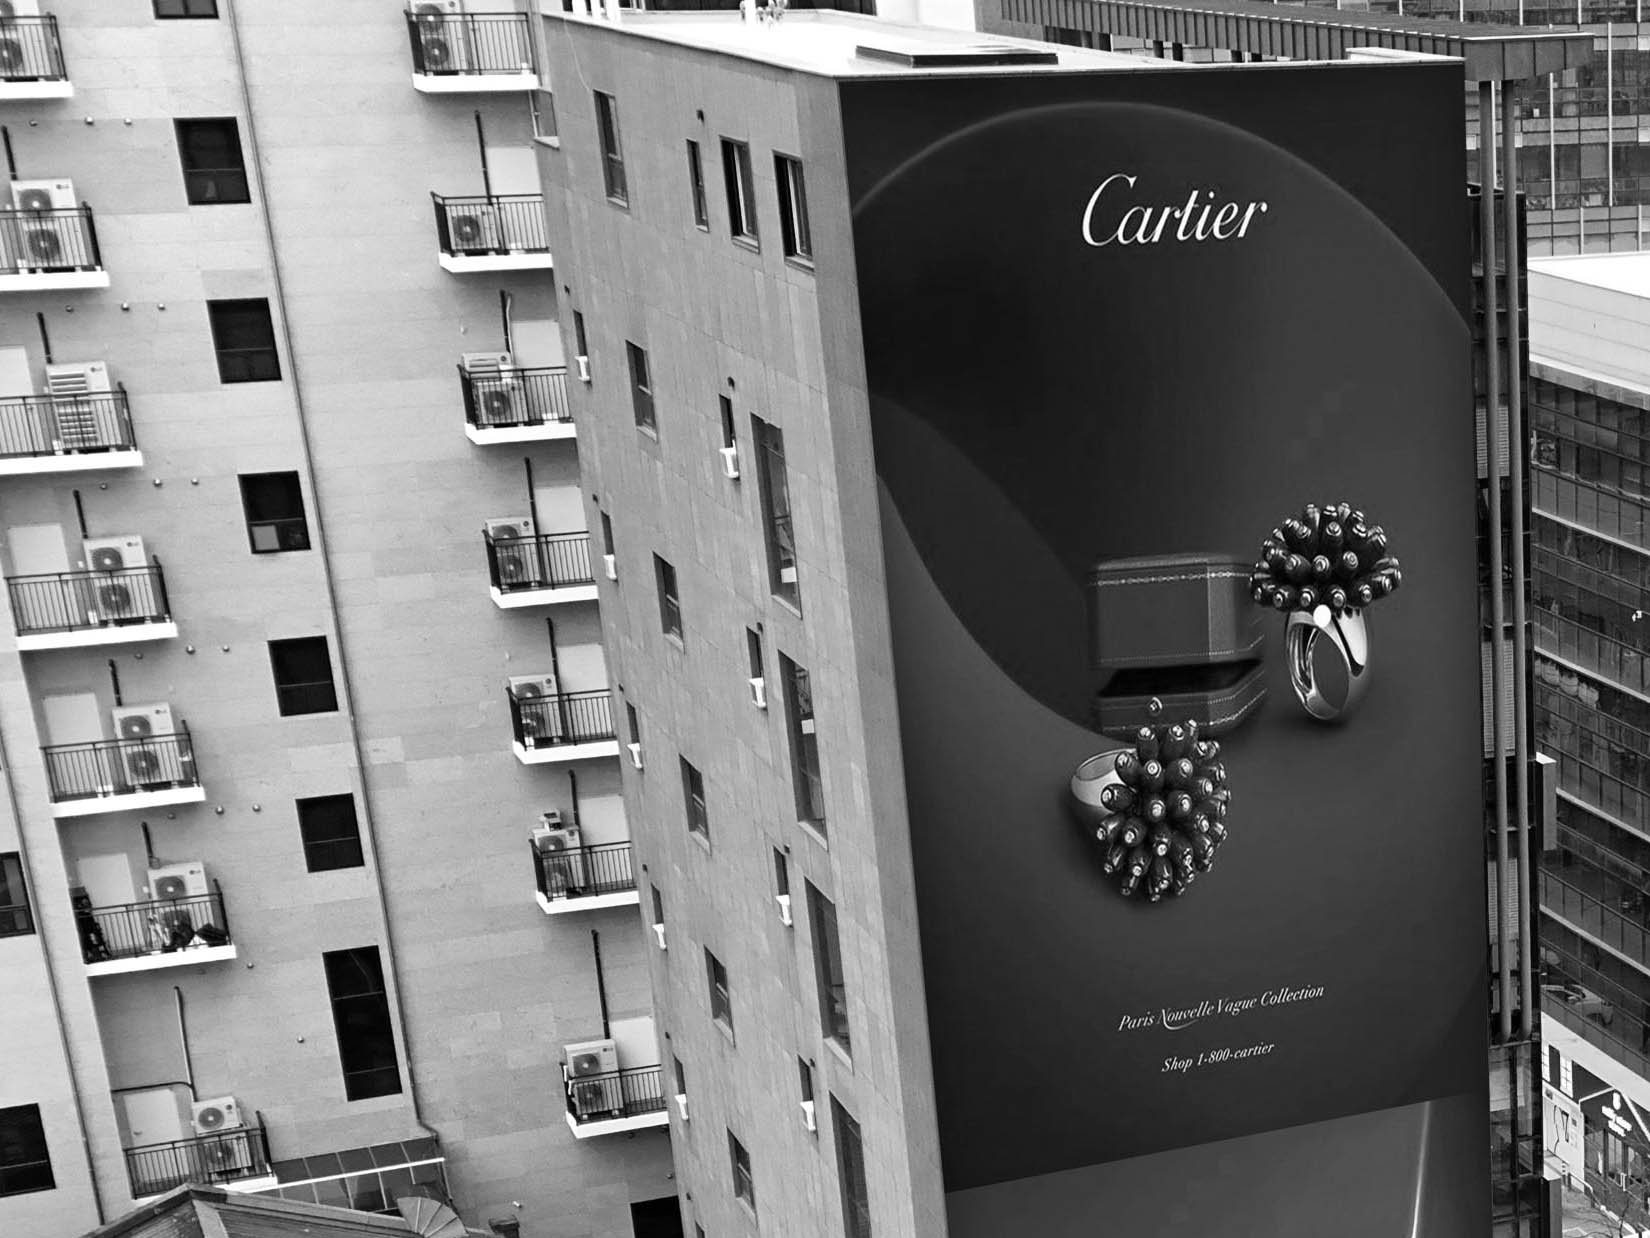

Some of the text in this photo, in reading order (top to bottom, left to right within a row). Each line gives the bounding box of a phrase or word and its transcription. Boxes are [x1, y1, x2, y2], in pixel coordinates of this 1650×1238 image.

[1082, 173, 1268, 246] Cartier
[1118, 984, 1324, 1031] Paris Nouvelle Vague Collection
[1161, 1041, 1275, 1073] Shop 1-800-cartier
